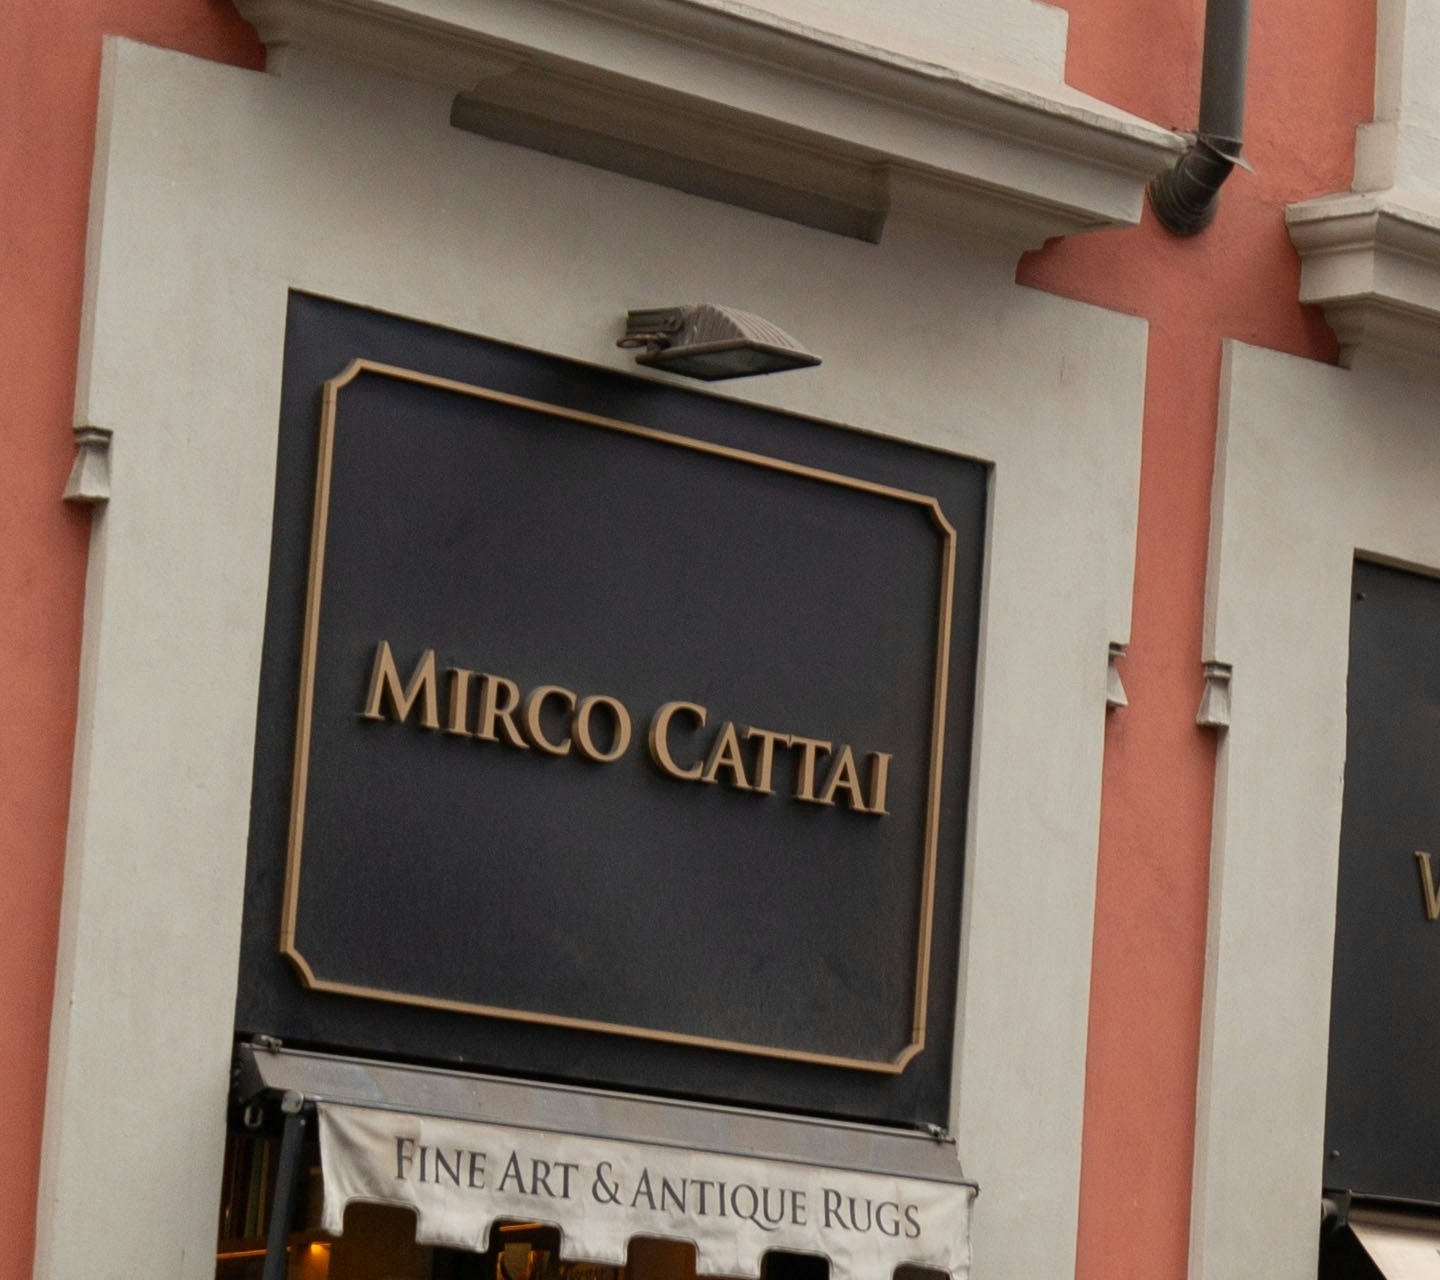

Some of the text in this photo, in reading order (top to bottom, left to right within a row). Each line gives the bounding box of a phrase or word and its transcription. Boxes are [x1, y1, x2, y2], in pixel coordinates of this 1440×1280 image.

[361, 640, 893, 816] MIRCO CATTAI
[392, 1134, 922, 1241] FINE ART & ANTIQUE RUGS
